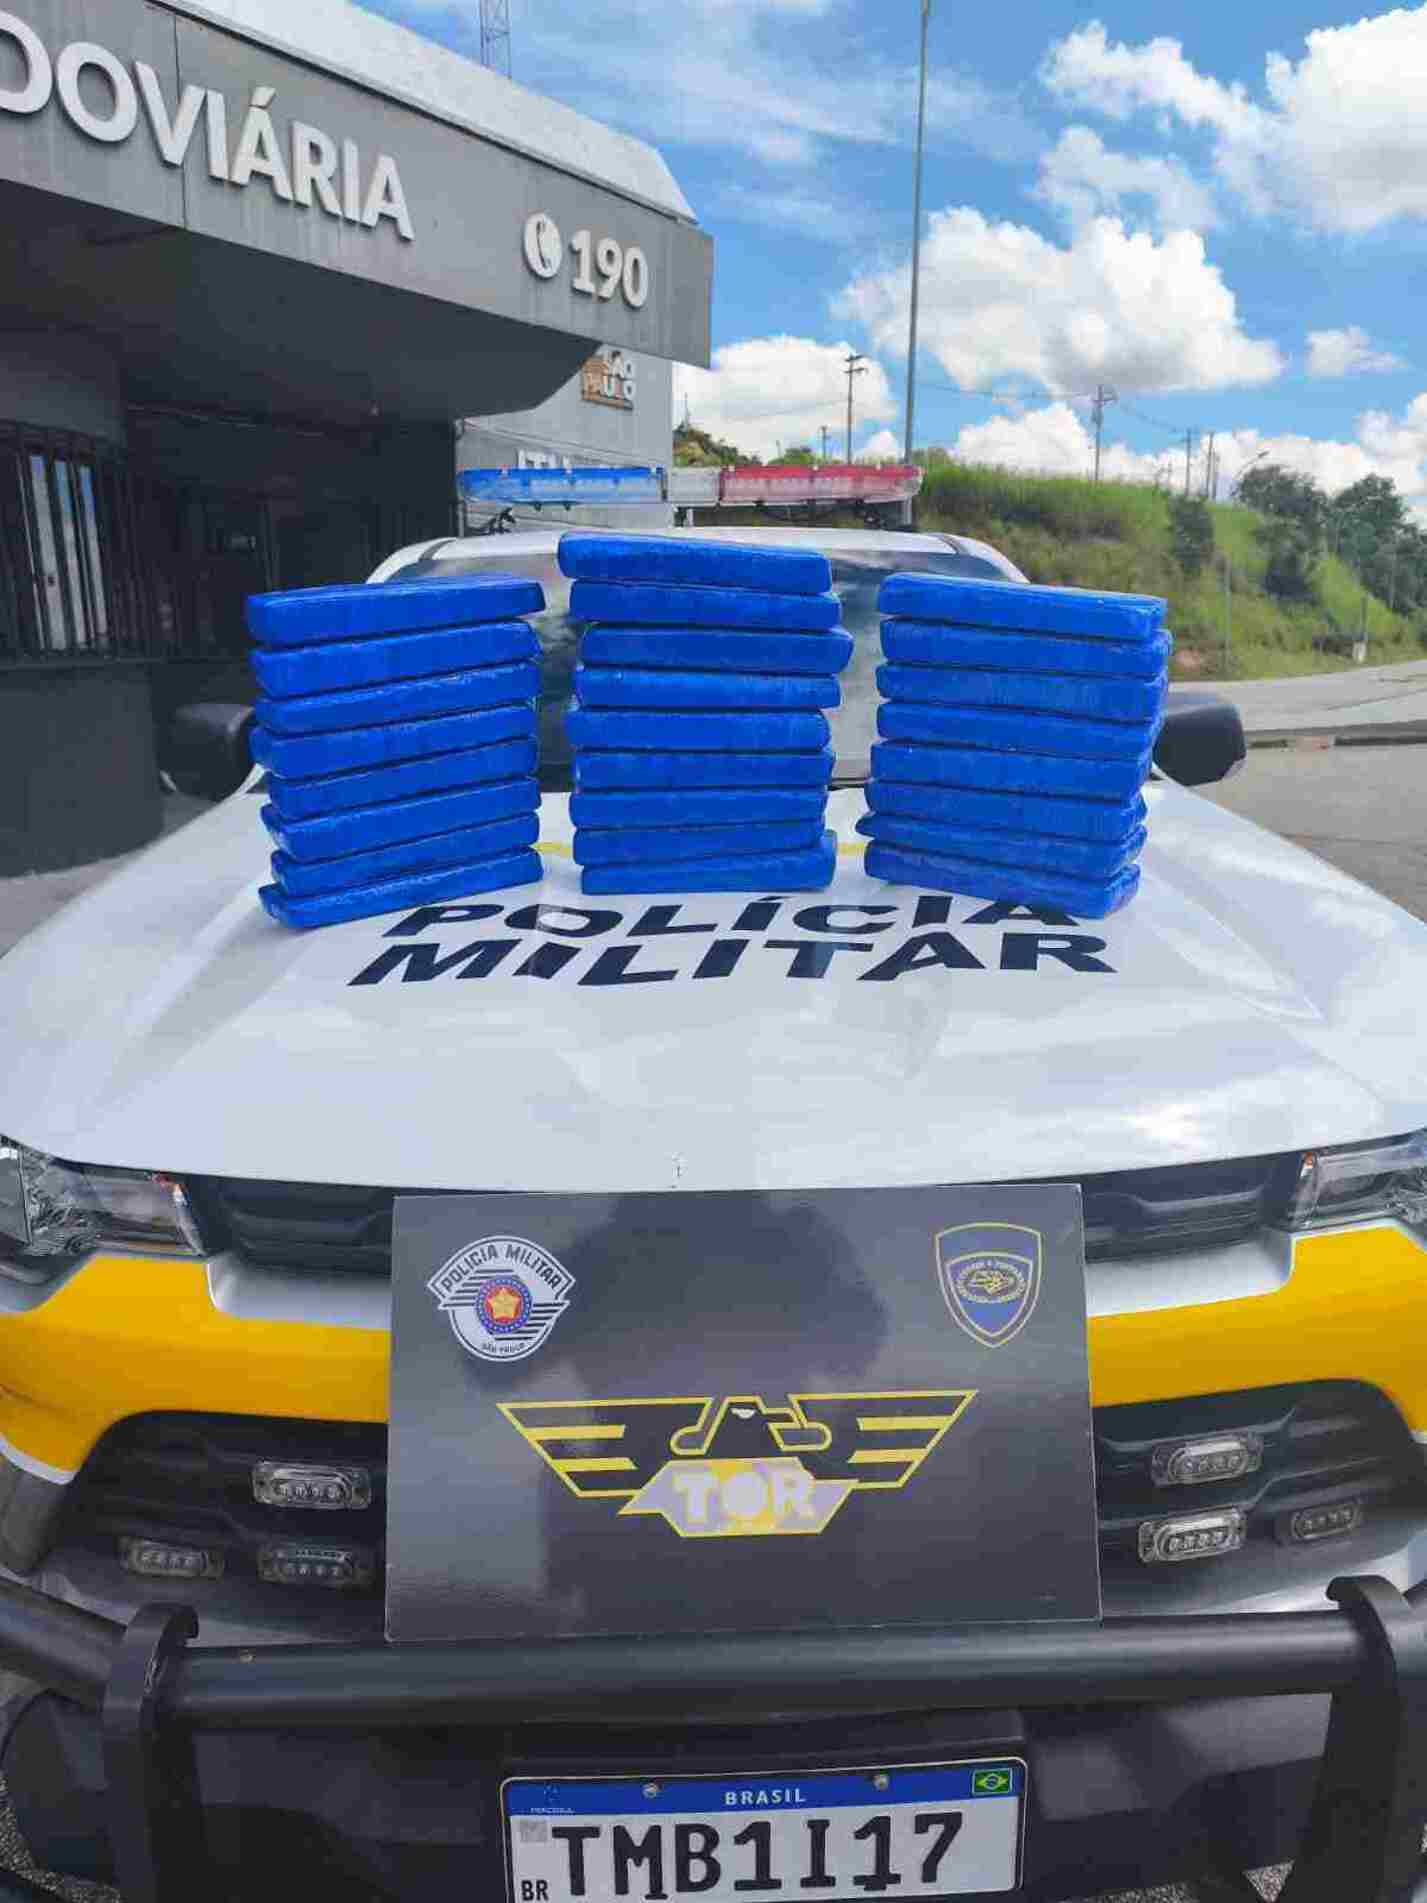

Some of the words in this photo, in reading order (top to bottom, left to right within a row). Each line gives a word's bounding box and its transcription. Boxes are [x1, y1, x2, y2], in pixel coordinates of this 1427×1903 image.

[569, 228, 649, 309] 190
[382, 895, 1079, 938] POLÍCIA
[347, 932, 1119, 986] MILITAR
[505, 1244, 562, 1291] MILITAR
[672, 1469, 816, 1524] TOR
[725, 1788, 807, 1806] BRASIL
[552, 1811, 964, 1900] TMB1I17
[521, 1880, 549, 1902] BR
